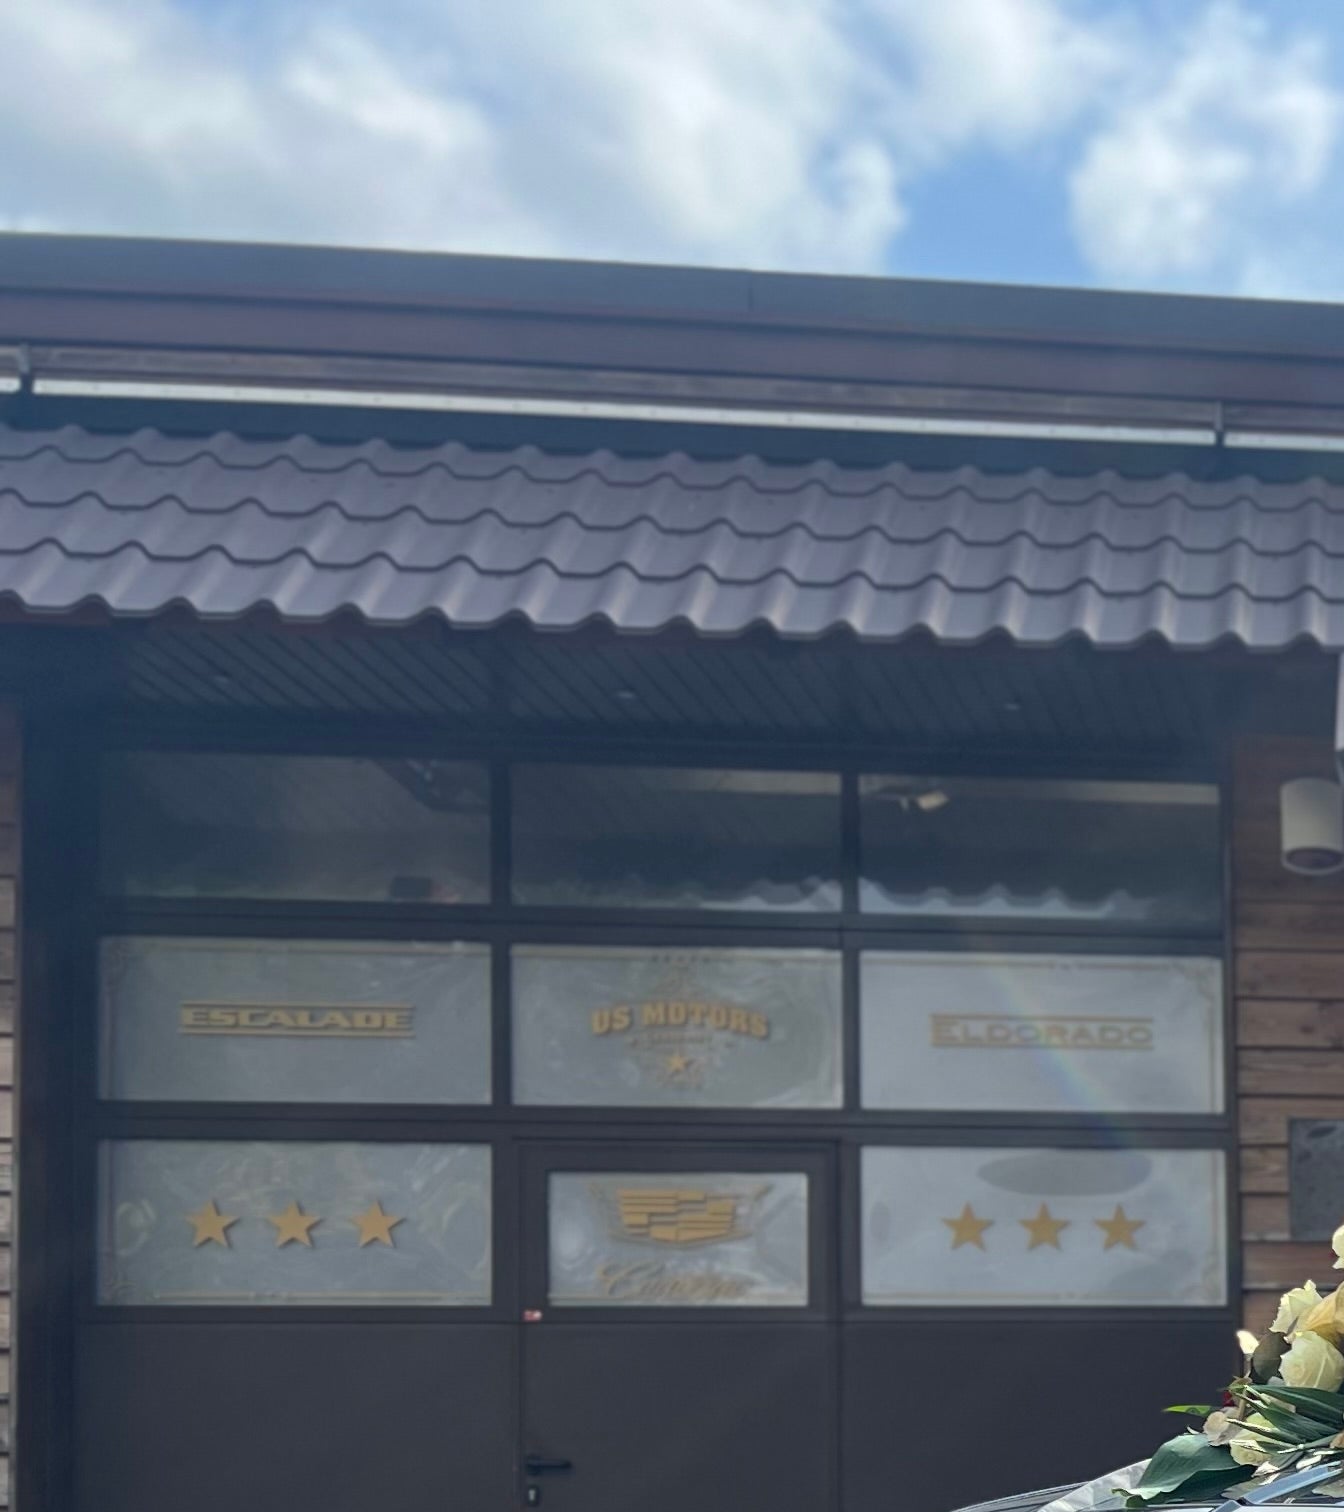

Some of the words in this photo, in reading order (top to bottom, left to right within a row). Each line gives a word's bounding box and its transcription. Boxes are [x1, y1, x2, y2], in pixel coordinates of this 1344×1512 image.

[181, 1006, 414, 1031] ESCALADE
[591, 1005, 632, 1036] US
[641, 1001, 769, 1040] MOTORS
[930, 1018, 1154, 1045] ELDORADO
